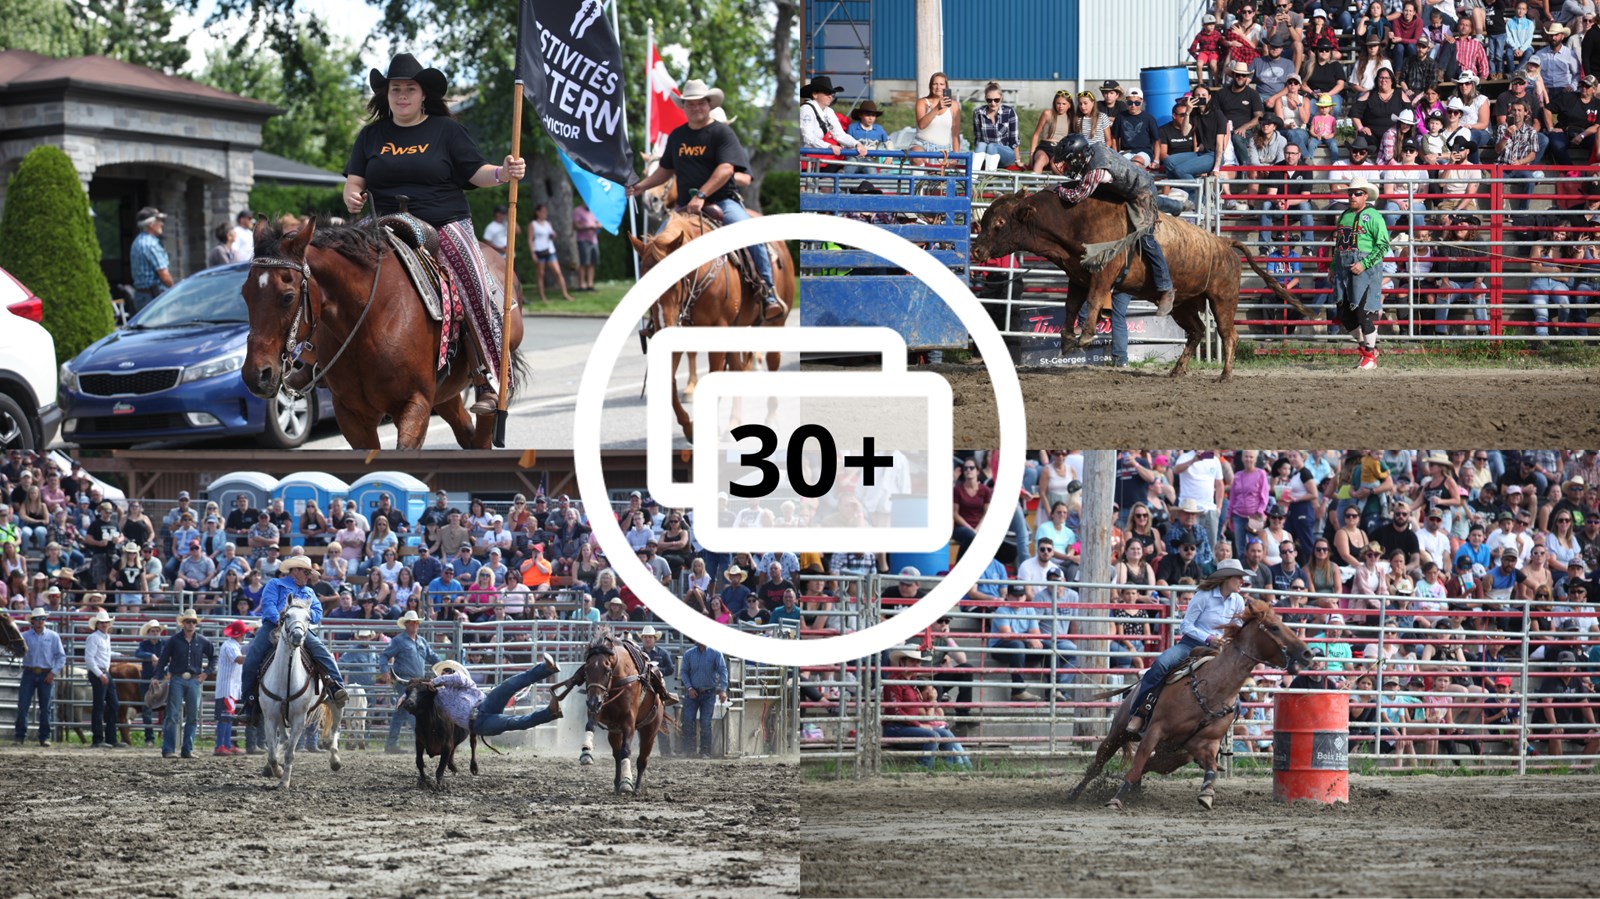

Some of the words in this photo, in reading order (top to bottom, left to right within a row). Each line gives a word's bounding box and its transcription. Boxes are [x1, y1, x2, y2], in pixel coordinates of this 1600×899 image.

[380, 142, 430, 156] FWSV
[678, 142, 707, 157] FWSV
[1040, 356, 1086, 365] St-Georges
[1316, 751, 1334, 761] Bois
